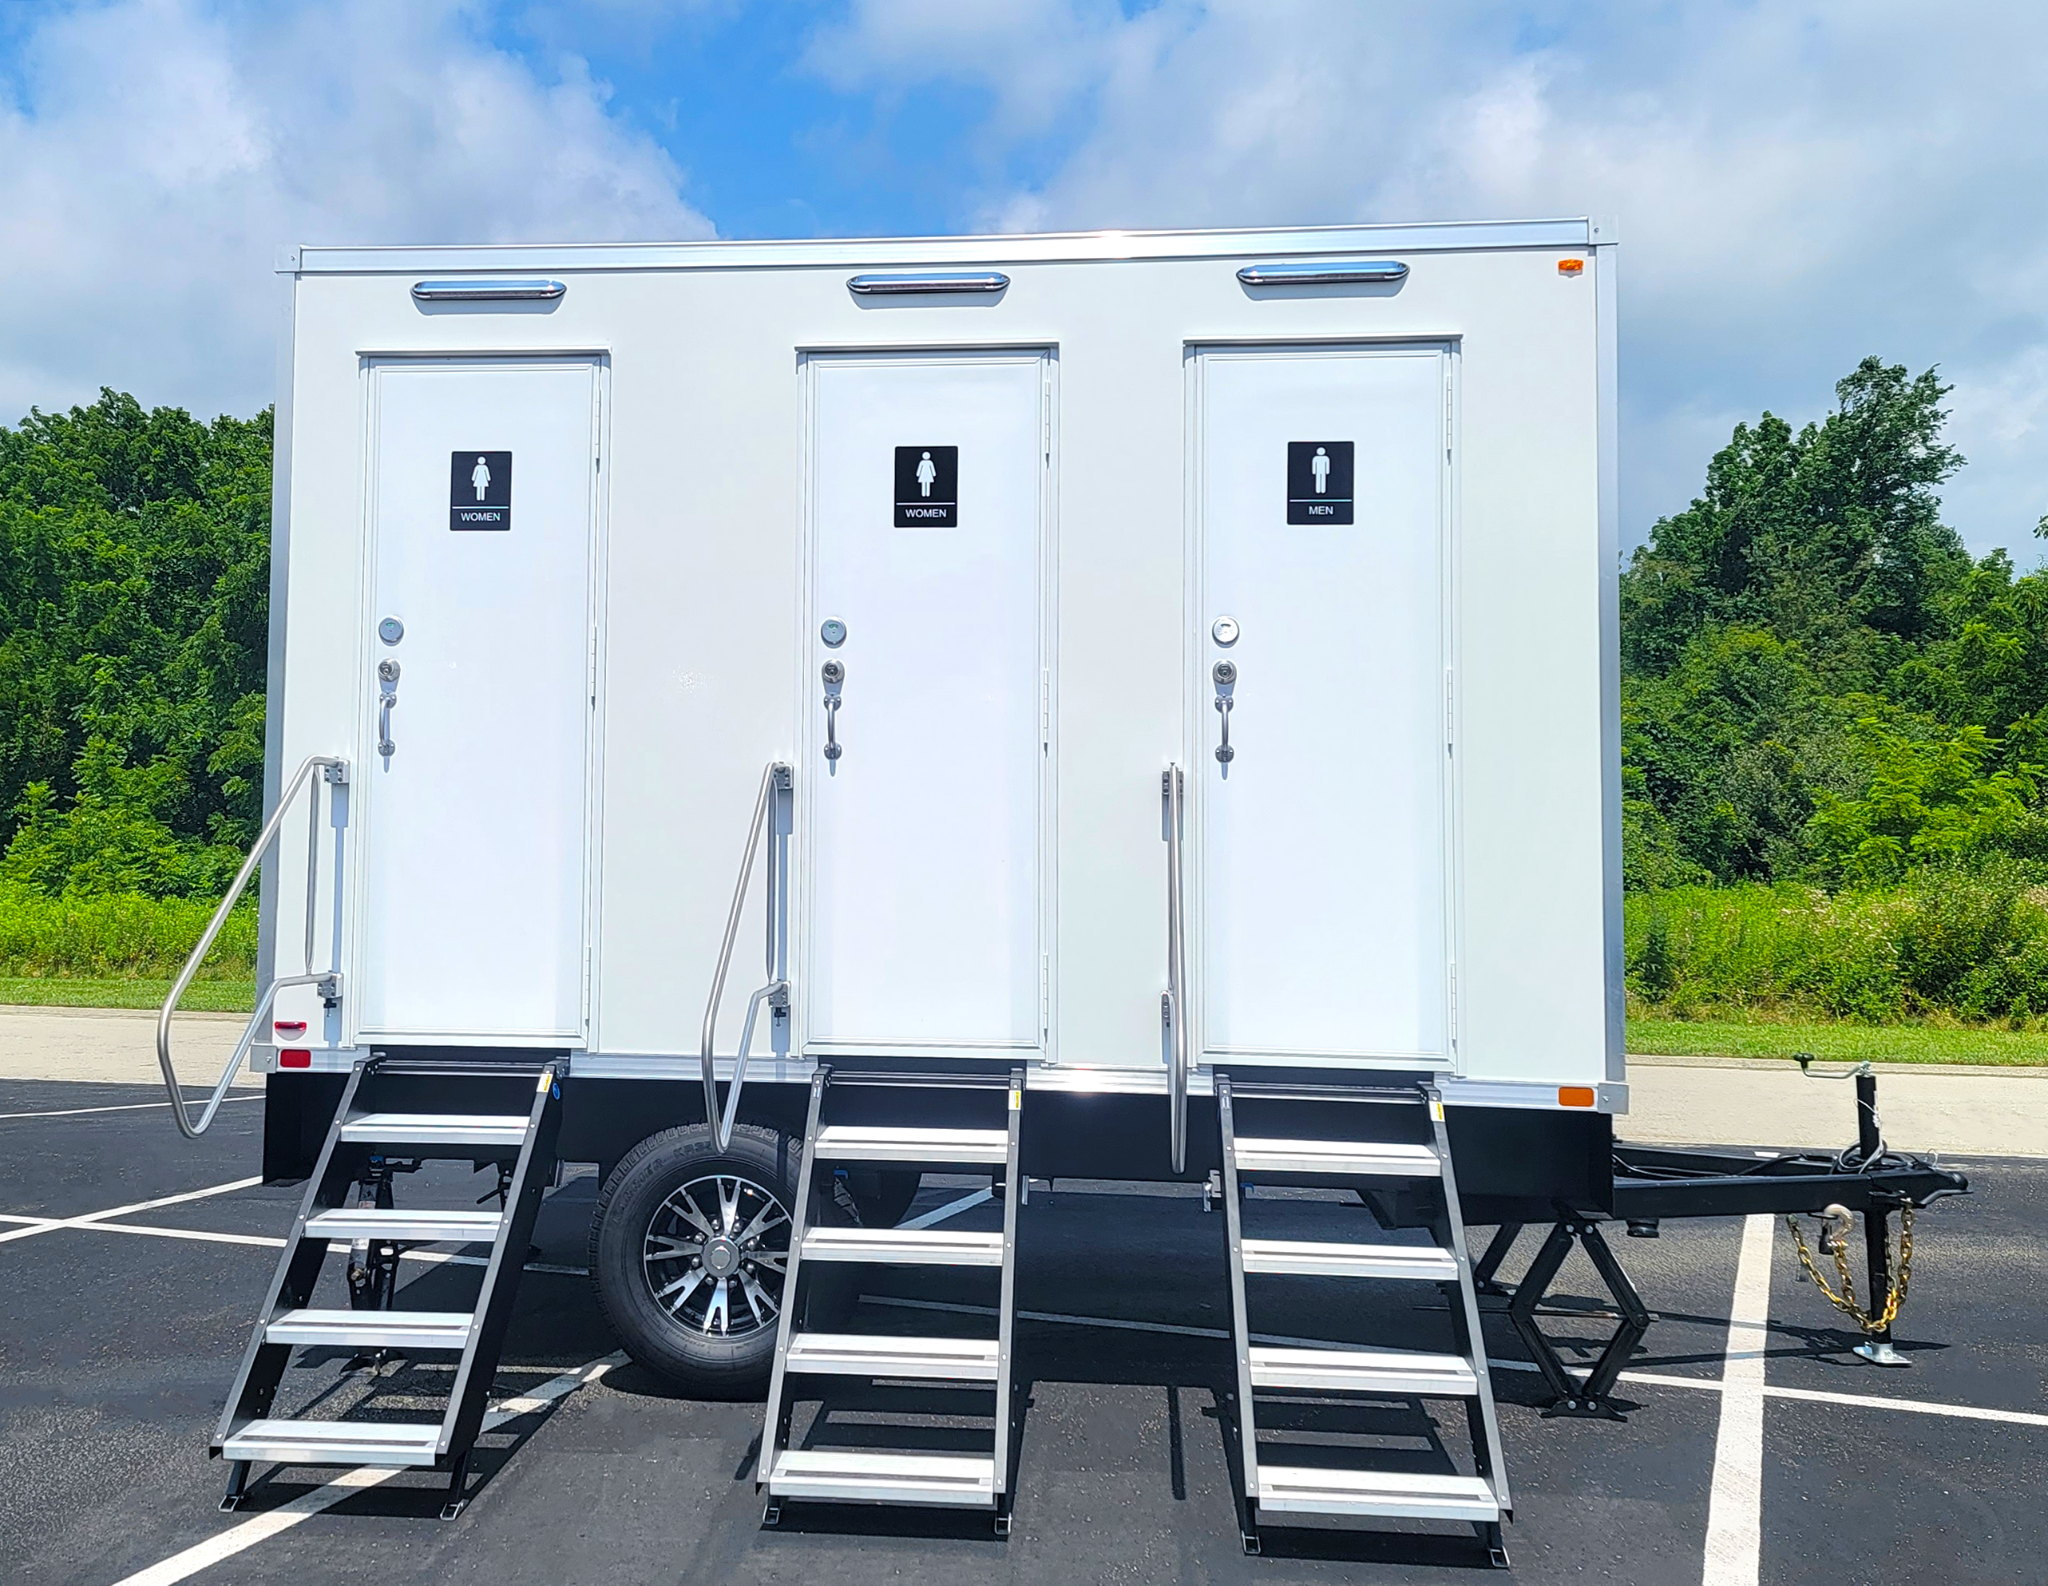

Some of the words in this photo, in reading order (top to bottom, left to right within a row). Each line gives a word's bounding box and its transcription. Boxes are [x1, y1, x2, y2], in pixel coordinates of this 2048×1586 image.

[905, 508, 947, 518] WOMEN
[1308, 505, 1334, 515] MEN
[460, 512, 501, 522] WOMEN
